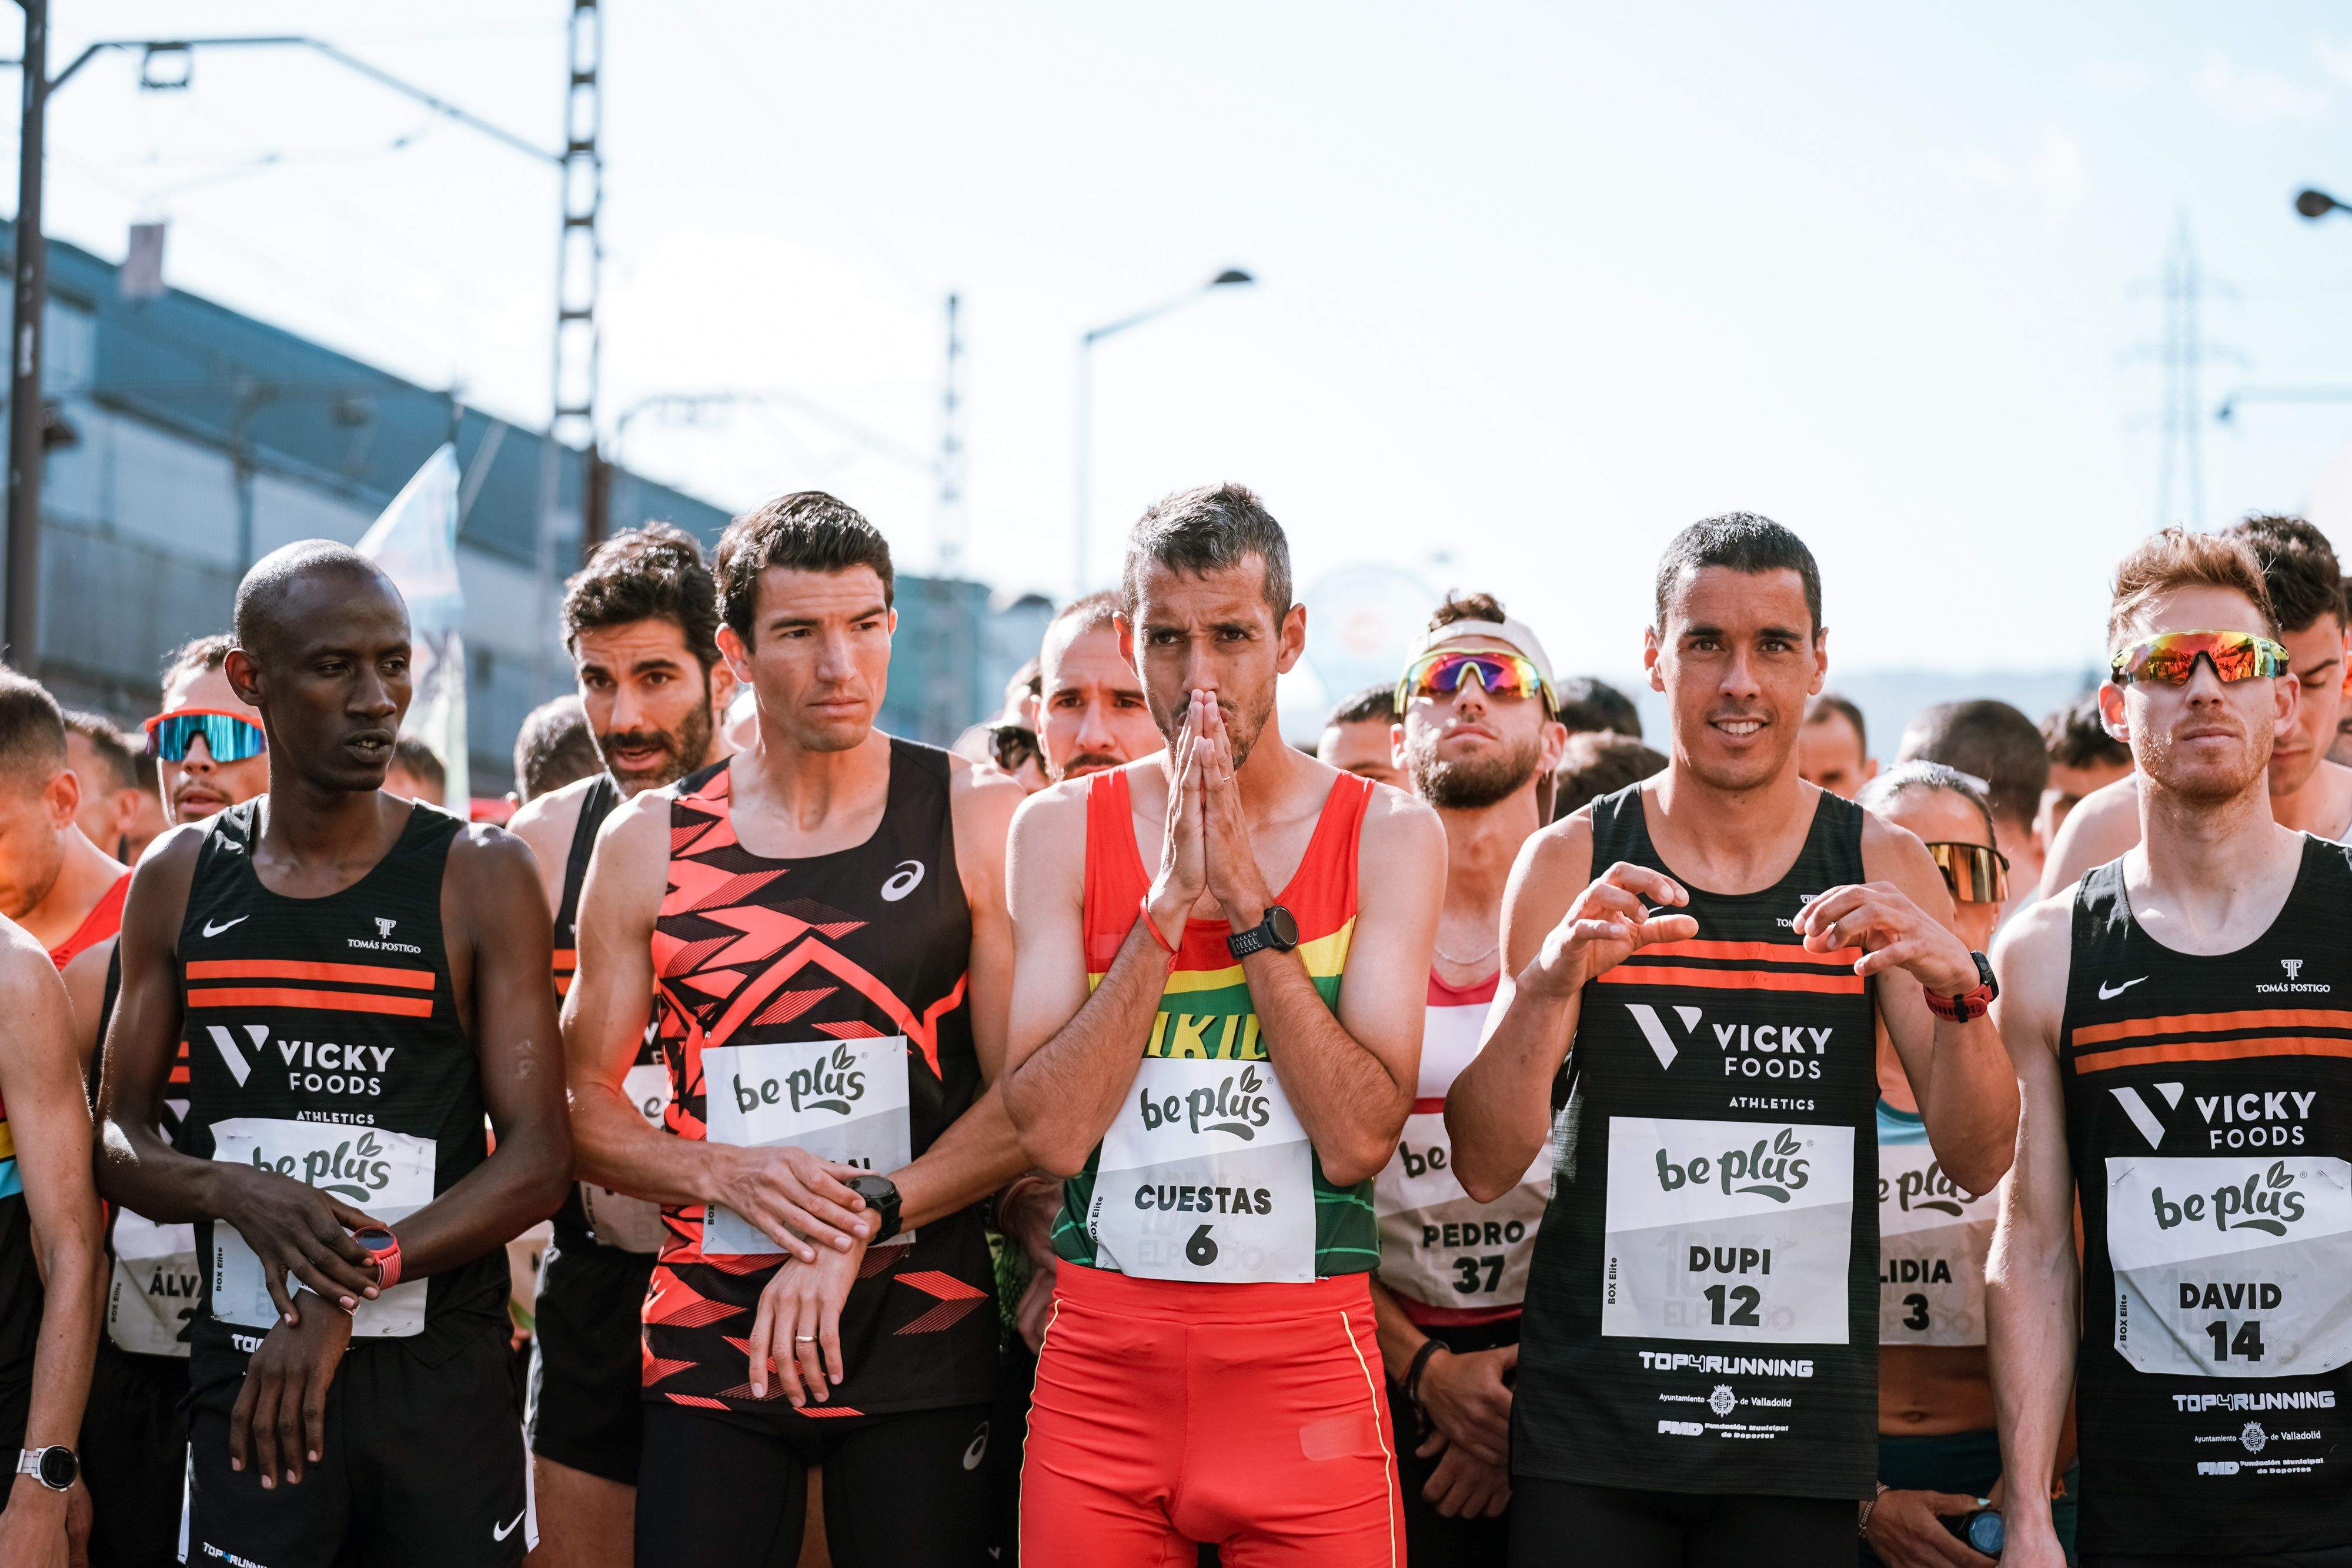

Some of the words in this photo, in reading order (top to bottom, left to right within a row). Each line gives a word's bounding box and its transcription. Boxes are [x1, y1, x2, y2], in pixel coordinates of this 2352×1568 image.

[348, 938, 379, 950] TOMÁS
[382, 942, 421, 954] POSTIGO
[2256, 982, 2288, 992] TOMÁS
[2290, 984, 2331, 992] POSTIGO
[1147, 1011, 1268, 1059] IKIL
[1712, 1024, 1833, 1054] VICKY
[277, 1040, 395, 1072] VICKY
[1725, 1057, 1821, 1079] FOODS
[289, 1072, 381, 1096] FOODS
[733, 1074, 781, 1114] be
[785, 1057, 866, 1112] plus
[296, 1110, 375, 1124] ATHLETICS
[1140, 1088, 1181, 1131] be
[1185, 1076, 1269, 1134] plus
[1729, 1096, 1815, 1111] ATHLETICS
[2194, 1091, 2316, 1124] VICKY
[2210, 1125, 2304, 1149] FOODS
[303, 1141, 392, 1190] plus
[1399, 1141, 1447, 1178] be
[1656, 1148, 1710, 1192] be
[1717, 1139, 1810, 1195] plus
[1092, 1196, 1103, 1218] Elite
[1135, 1184, 1272, 1215] CUESTAS
[2151, 1186, 2205, 1230] be
[2211, 1174, 2305, 1232] plus
[1185, 1225, 1218, 1266] 6
[1422, 1220, 1525, 1248] PEDRO
[1452, 1254, 1505, 1293] 37
[1609, 1257, 1617, 1280] Elite
[1689, 1245, 1770, 1275] DUPI
[149, 1266, 202, 1298] ÁLV
[2180, 1283, 2281, 1309] DAVID
[1703, 1285, 1760, 1326] 12
[1903, 1293, 1929, 1330] 3
[2206, 1321, 2264, 1361] 14
[1639, 1351, 1813, 1378] TOP4RUNNING
[1659, 1393, 1705, 1403] Ayuntamiento
[1751, 1397, 1792, 1407] Valladolid
[2173, 1390, 2336, 1412] TOP4RUNNING
[1658, 1420, 1703, 1436] FMD
[2194, 1435, 2236, 1443] Ayuntamiento
[2281, 1430, 2321, 1440] Valladolid
[2197, 1461, 2240, 1475] FMD
